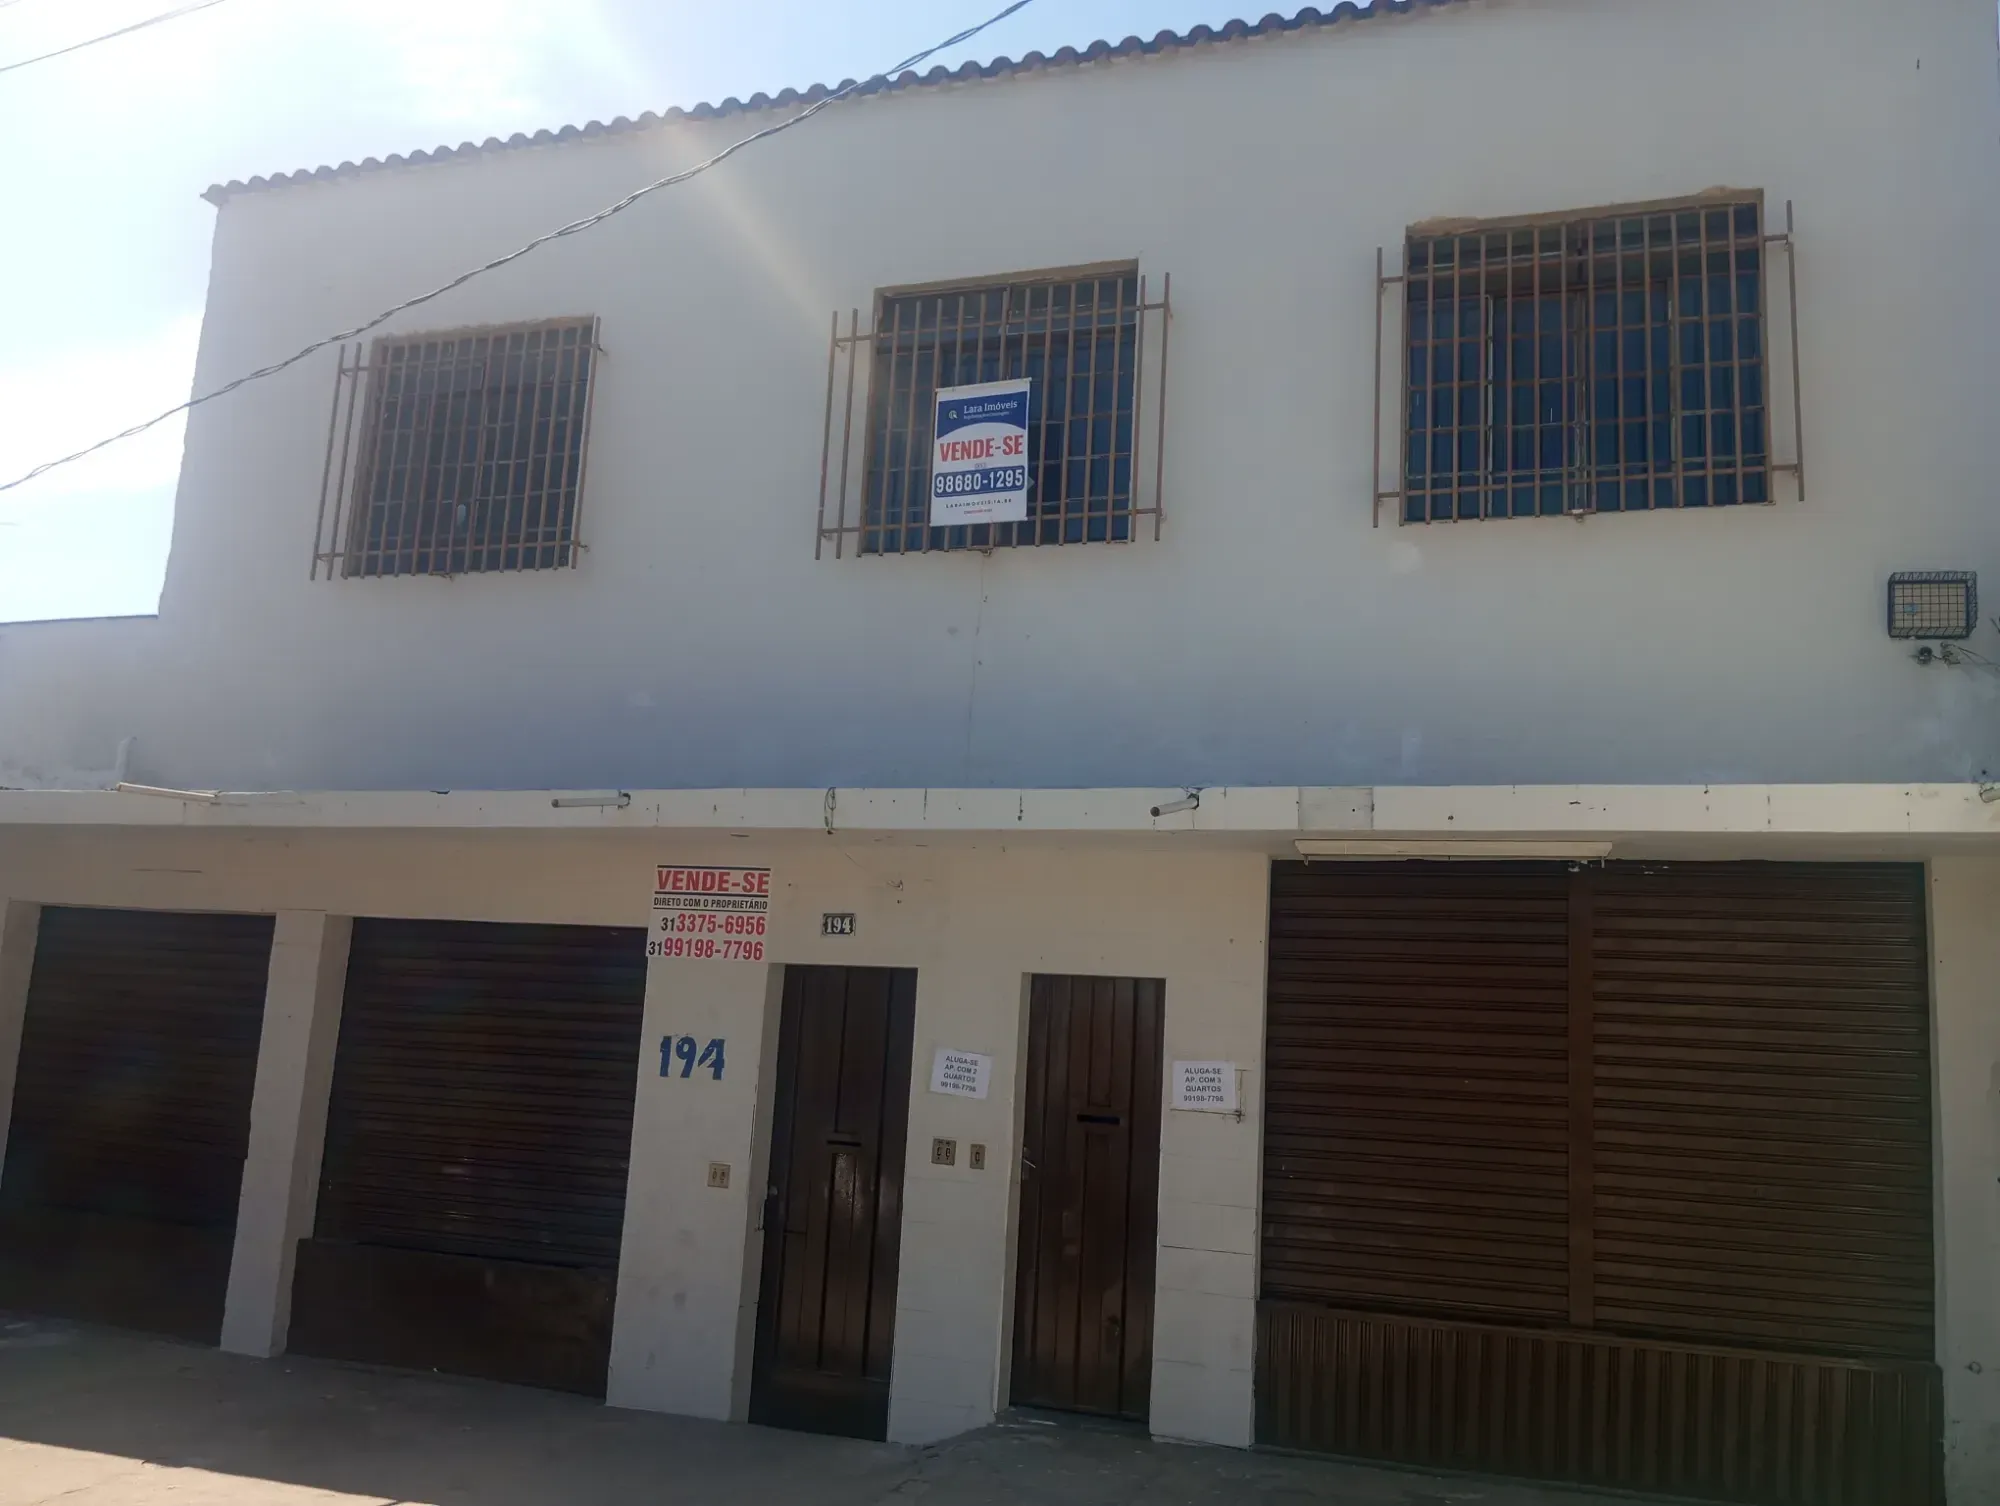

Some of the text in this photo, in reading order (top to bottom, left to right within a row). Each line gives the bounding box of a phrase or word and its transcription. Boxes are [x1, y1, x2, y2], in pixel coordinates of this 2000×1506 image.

[963, 399, 1018, 415] Lara Imóveis
[939, 434, 1024, 463] VENDE-SE
[936, 468, 1023, 494] 98680-1295
[657, 869, 770, 894] VENDE-SE
[653, 897, 768, 910] DIRETO COM O PROPRIETÁRIO
[826, 915, 853, 935] 194
[659, 1035, 726, 1081] 194
[945, 1055, 979, 1067] ALUGA-SE
[956, 1066, 972, 1074] COM
[1184, 1067, 1222, 1075] ALUGA-SE
[943, 1072, 976, 1083] QUARTOS
[1185, 1076, 1197, 1084] AP.
[1198, 1076, 1215, 1084] COM
[1185, 1085, 1222, 1093] QUARTOS
